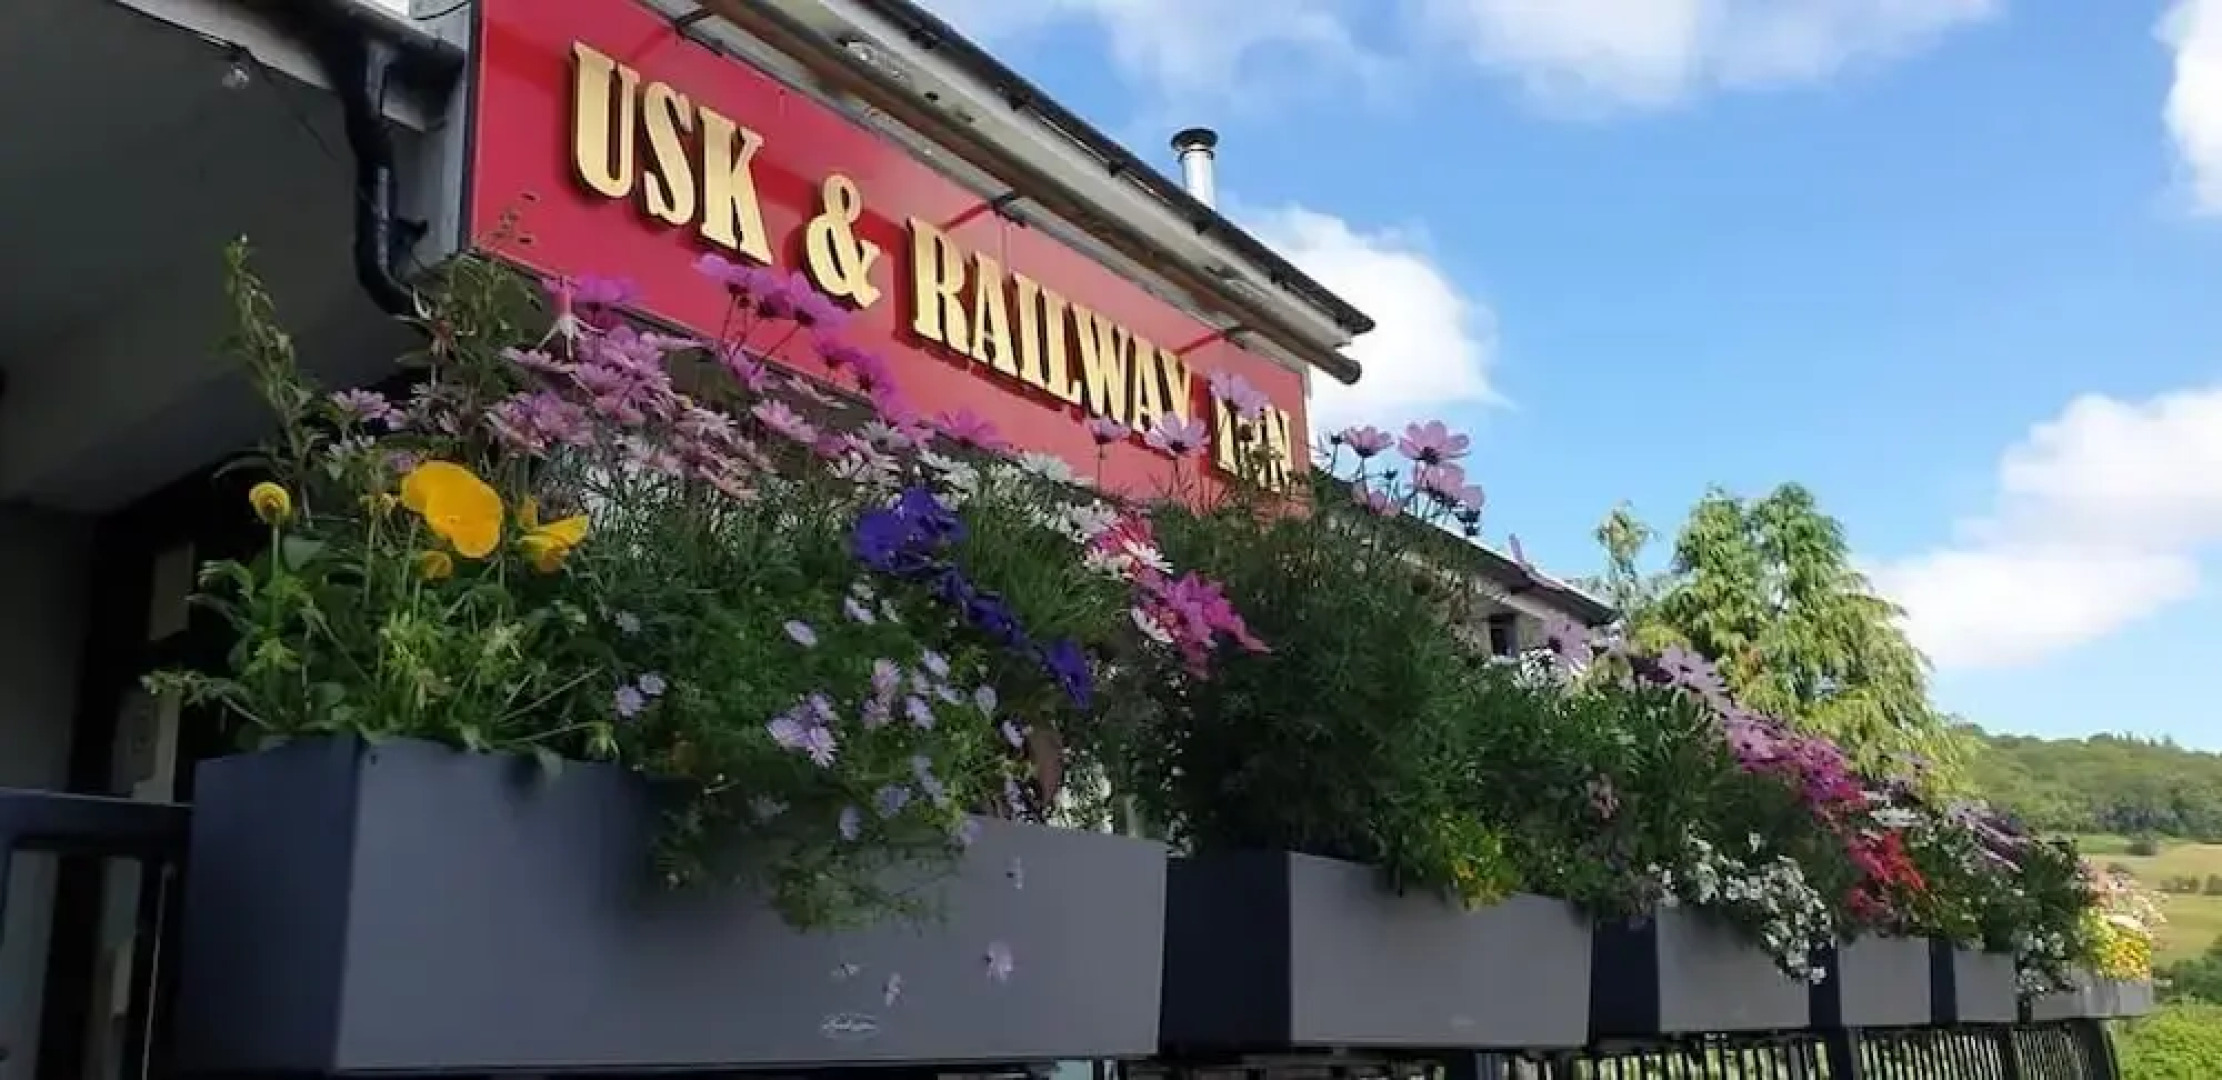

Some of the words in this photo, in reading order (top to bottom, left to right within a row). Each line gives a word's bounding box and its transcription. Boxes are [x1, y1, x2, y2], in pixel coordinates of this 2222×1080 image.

[572, 39, 773, 266] USK
[806, 173, 882, 309] &
[908, 216, 1192, 434] RAILWAY
